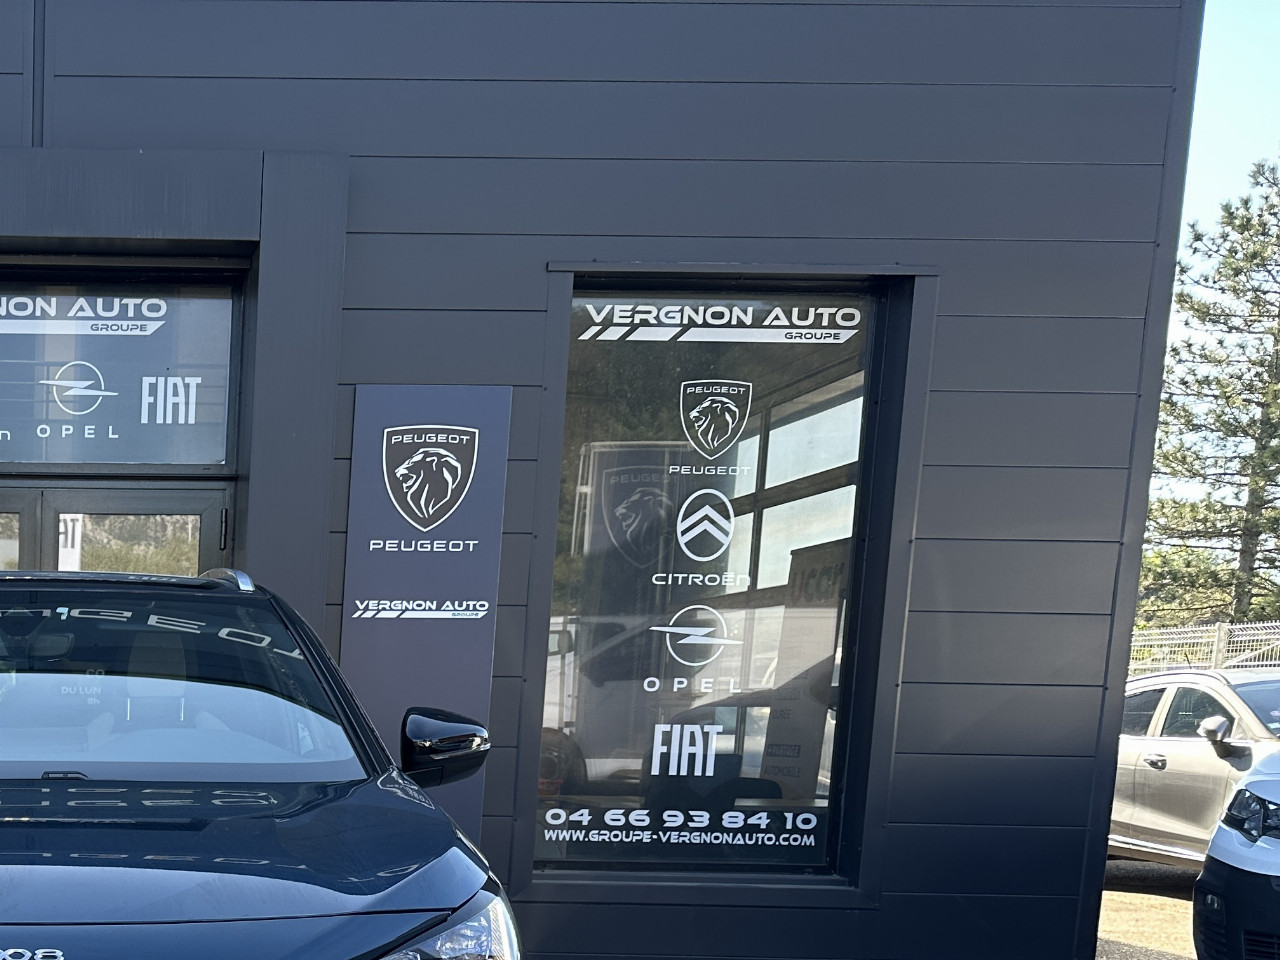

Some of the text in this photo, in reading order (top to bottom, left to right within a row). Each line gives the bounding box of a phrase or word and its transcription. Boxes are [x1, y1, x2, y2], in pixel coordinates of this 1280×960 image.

[67, 297, 168, 318] AUTO
[584, 304, 862, 327] VERGNON AUTO
[90, 323, 148, 332] GROUPE
[784, 332, 841, 340] GROUPE
[686, 386, 746, 395] PEUGEOT
[140, 376, 202, 424] FIAT
[36, 424, 119, 439] OPEL
[391, 433, 470, 444] PEUGEOT
[668, 465, 751, 475] PEUGEOT
[369, 540, 479, 552] PEUGEOT
[651, 571, 751, 586] CITROËN
[355, 600, 489, 611] VERGNON AUTO
[643, 677, 742, 693] OPEL
[651, 723, 723, 777] FIAT
[545, 808, 818, 830] 04 66 93 84 10
[544, 829, 816, 847] WWW.GROUPE-VERGNONAUTO.COM
